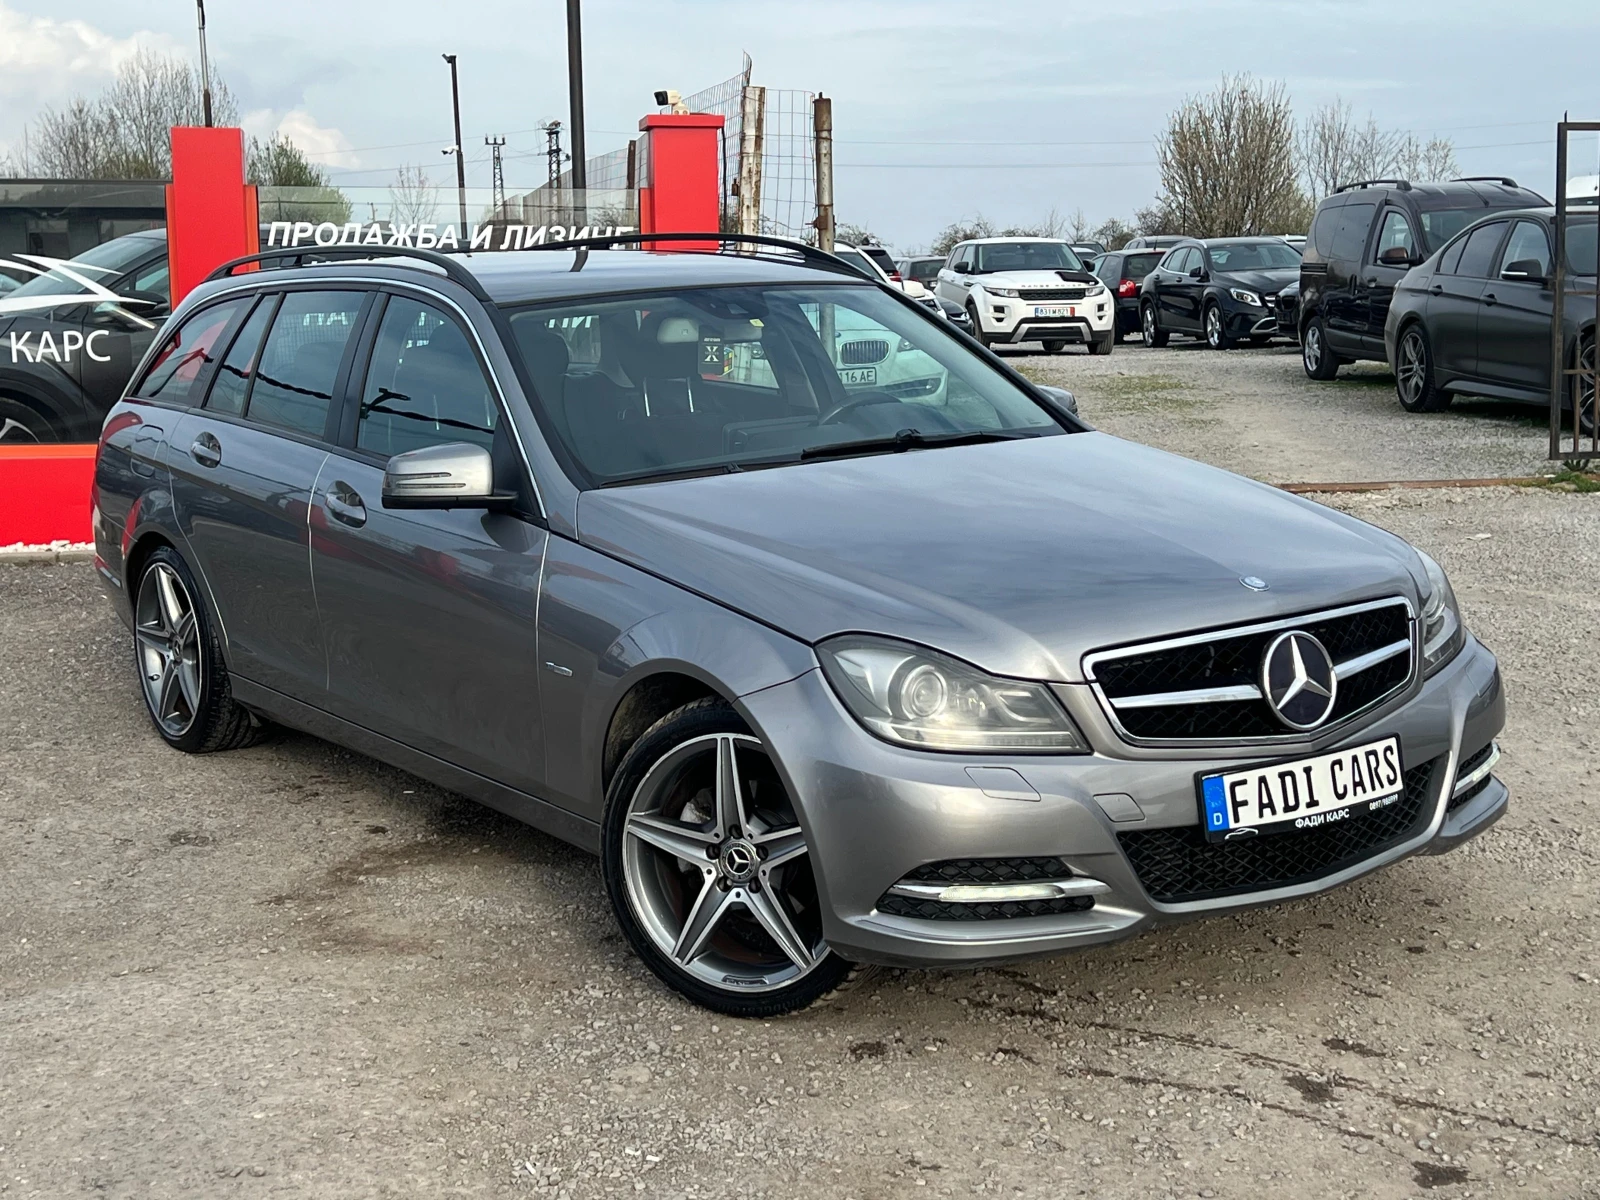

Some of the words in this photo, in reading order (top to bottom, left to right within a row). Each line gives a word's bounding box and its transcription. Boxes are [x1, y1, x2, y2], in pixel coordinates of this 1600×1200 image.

[267, 221, 459, 249] ПРОДАЖБА
[469, 225, 494, 250] И
[10, 330, 111, 364] КАРС
[1229, 765, 1320, 824] FADI
[1330, 745, 1398, 801] CARS
[1213, 812, 1223, 826] D
[1295, 812, 1325, 828] ФАДИ
[1326, 808, 1350, 823] КАРС
